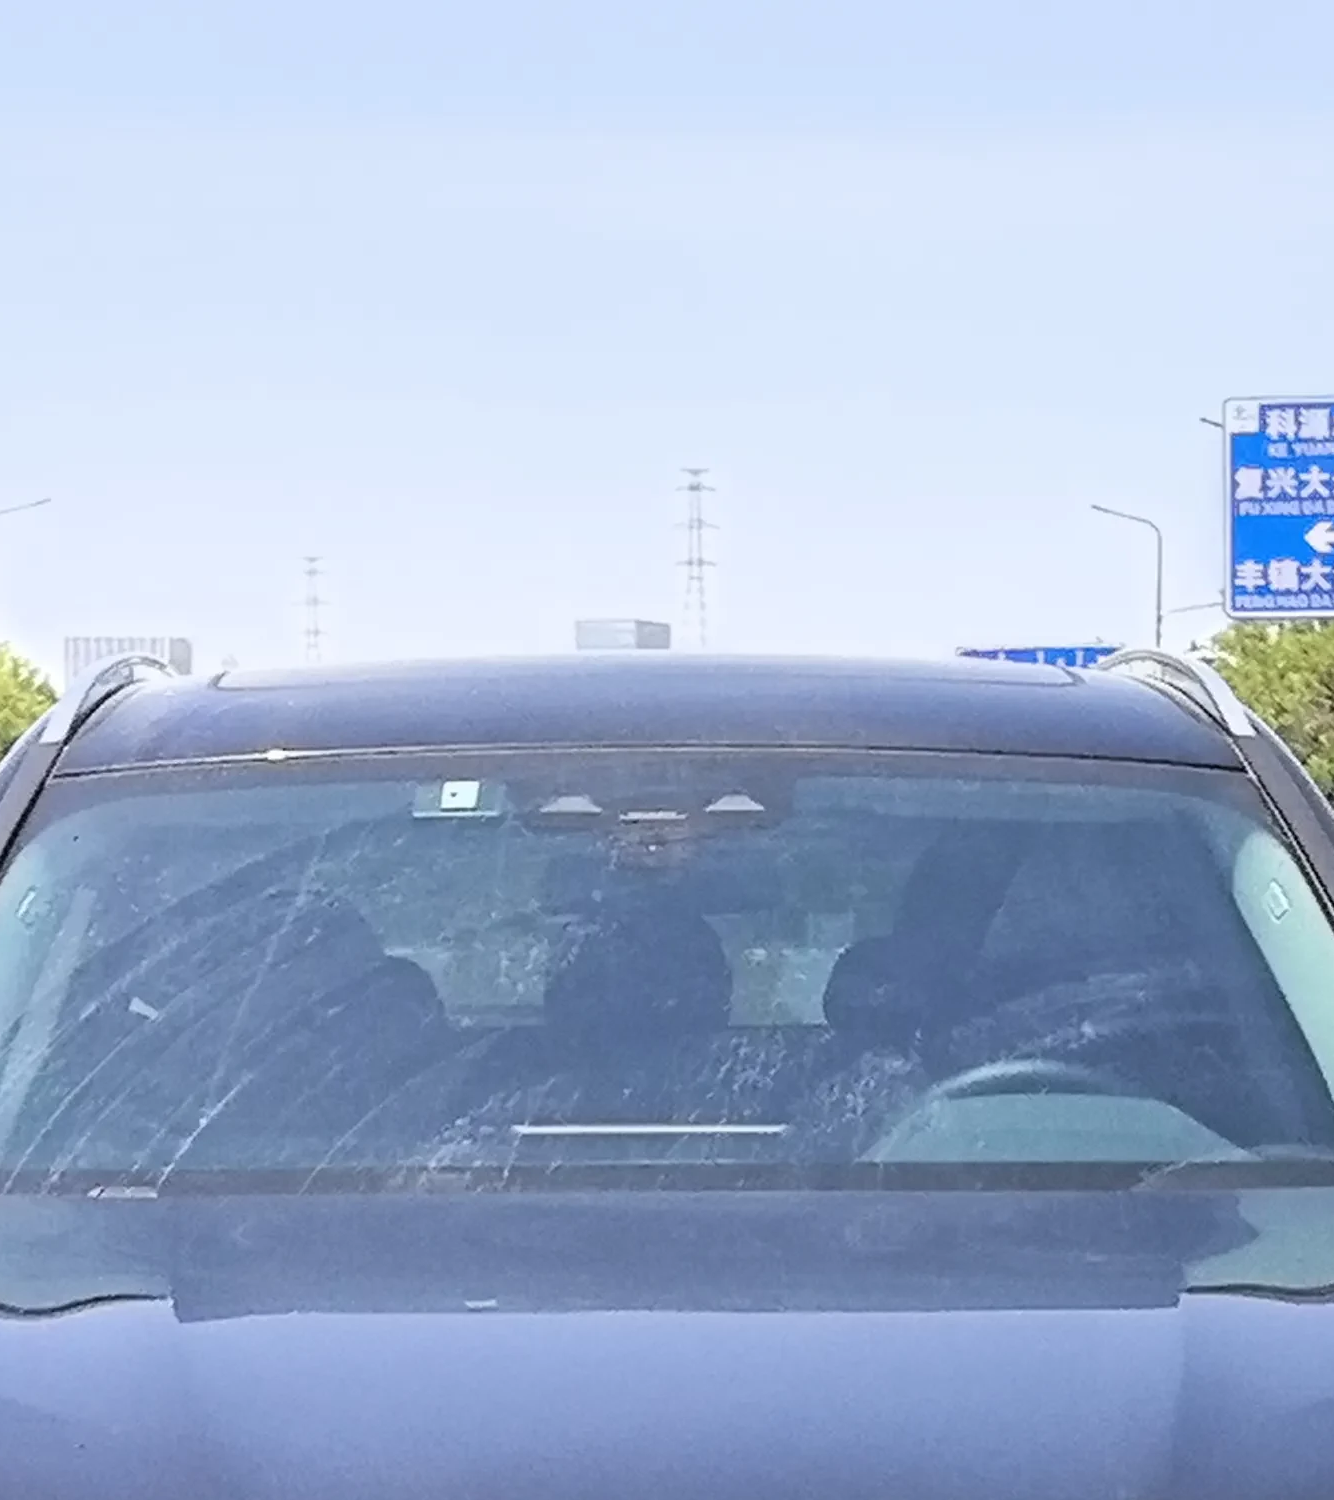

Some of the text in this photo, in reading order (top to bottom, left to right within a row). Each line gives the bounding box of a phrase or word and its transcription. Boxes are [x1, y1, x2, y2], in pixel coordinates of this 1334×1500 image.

[1261, 500, 1300, 516] XING
[1301, 500, 1325, 516] DA
[1234, 594, 1275, 609] FENG
[1276, 593, 1309, 608] HAO
[1310, 593, 1334, 608] DA
